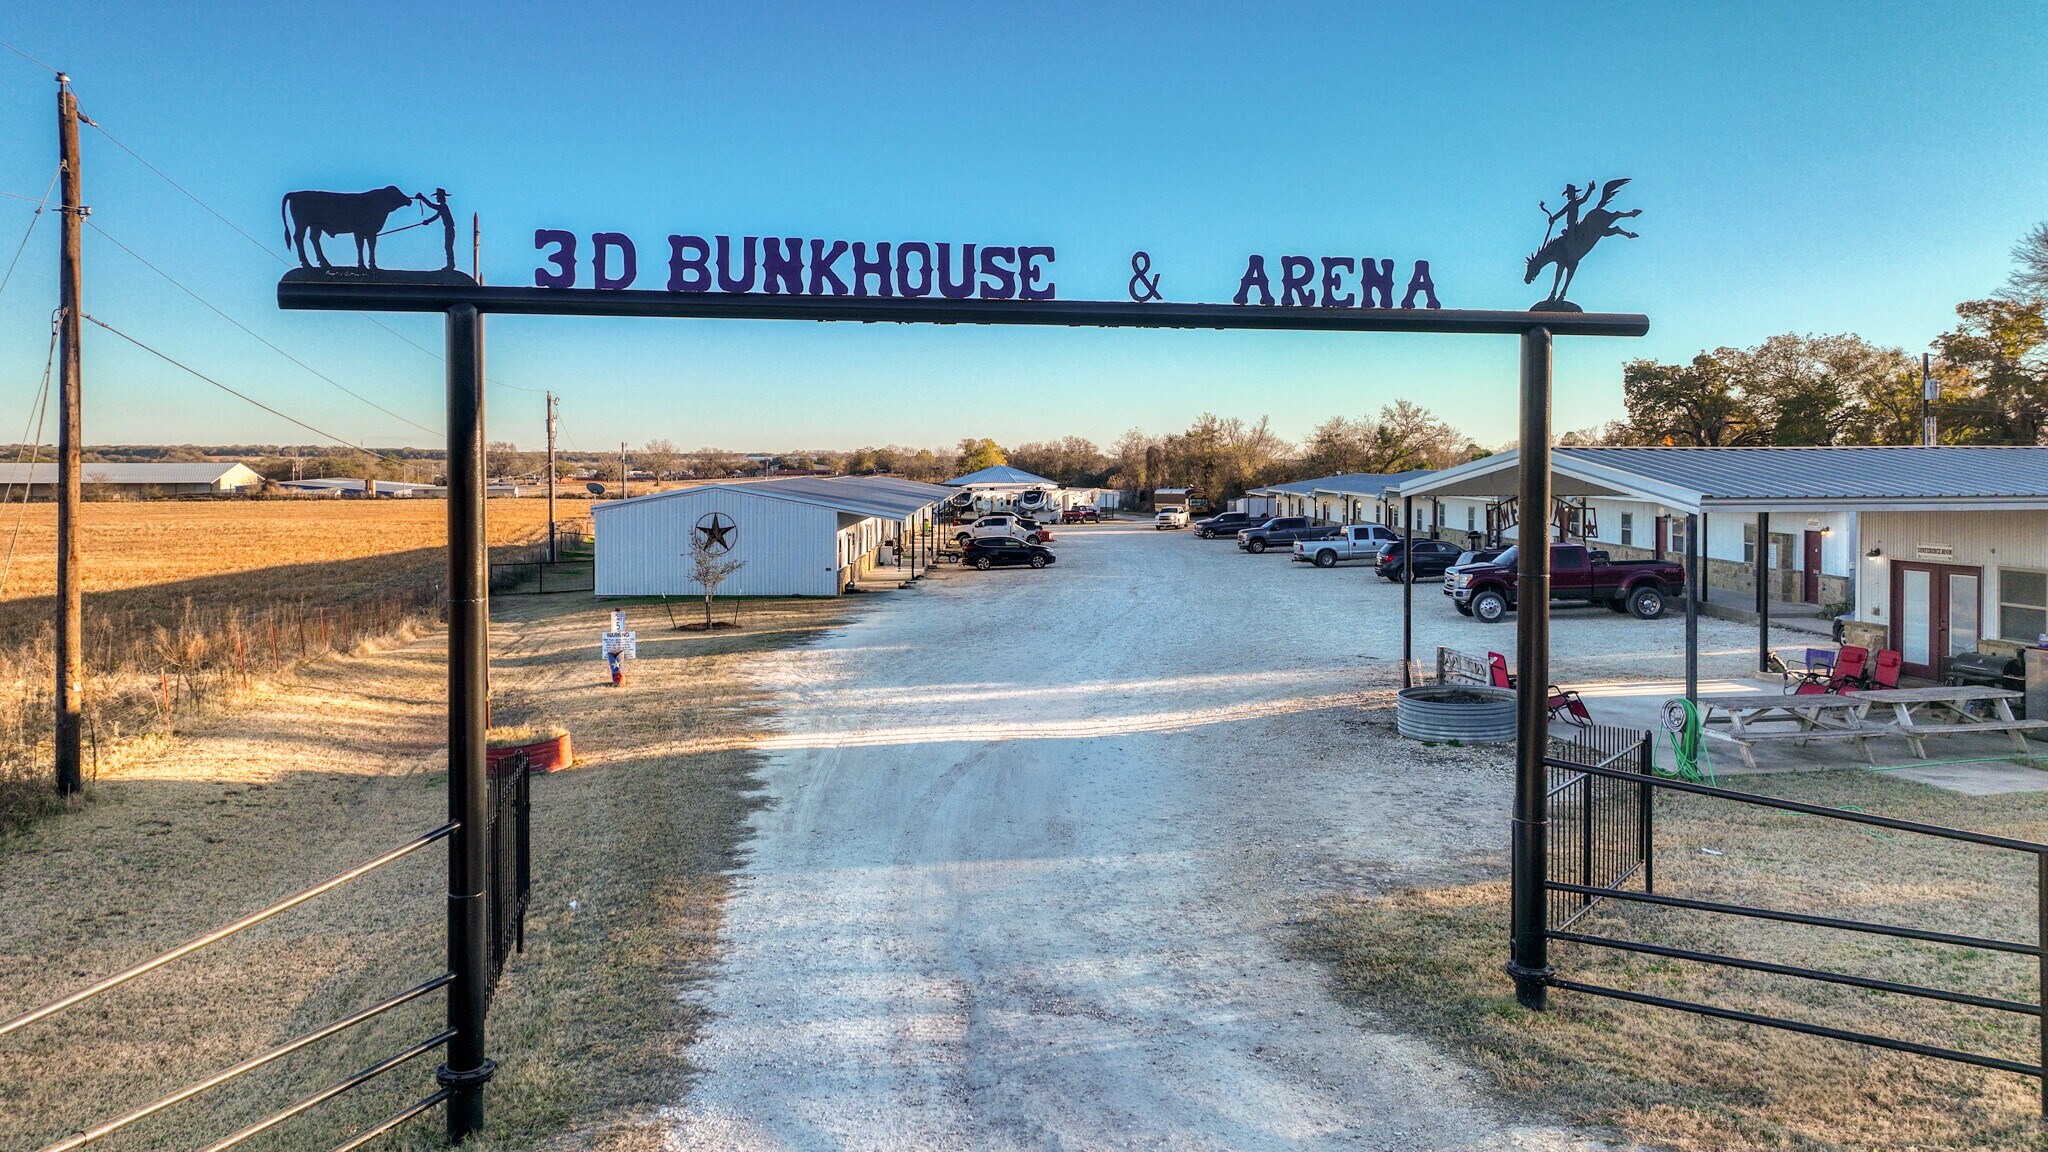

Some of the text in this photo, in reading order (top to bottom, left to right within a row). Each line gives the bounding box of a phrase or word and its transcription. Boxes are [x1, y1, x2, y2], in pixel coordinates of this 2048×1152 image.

[667, 233, 1056, 301] BUNKHOUSE
[1129, 251, 1162, 303] &
[1233, 254, 1442, 310] ARENA
[615, 621, 621, 630] 5
